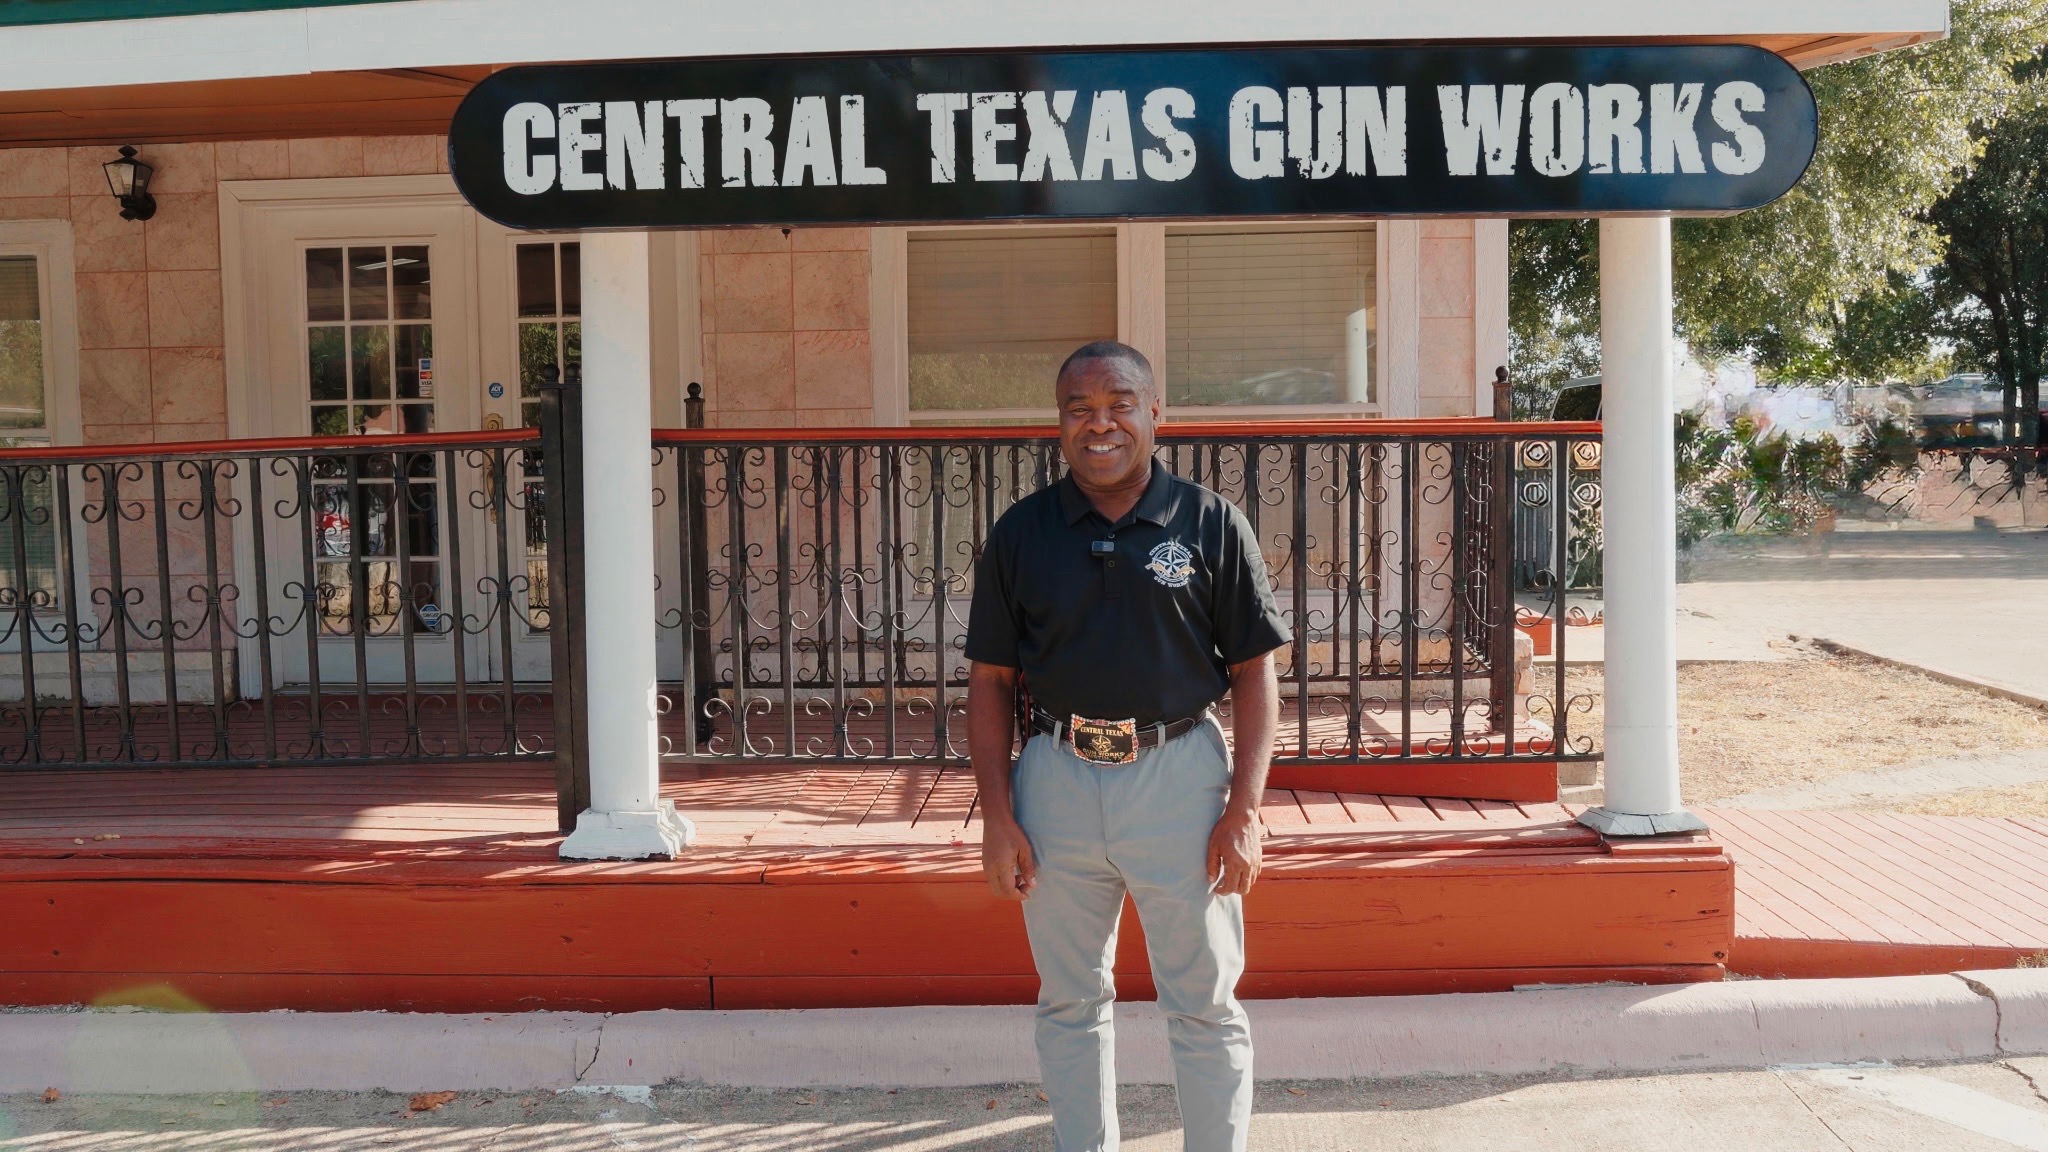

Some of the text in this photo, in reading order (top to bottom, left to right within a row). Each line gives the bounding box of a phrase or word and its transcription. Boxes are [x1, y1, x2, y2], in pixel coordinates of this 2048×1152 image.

[502, 81, 1766, 195] CENTRAL TEXAS GUN WORKS
[1149, 541, 1194, 558] CENTRAL TEXAS
[1154, 576, 1189, 588] GUN WORKS
[1080, 727, 1124, 737] CENTRAL TEXAS
